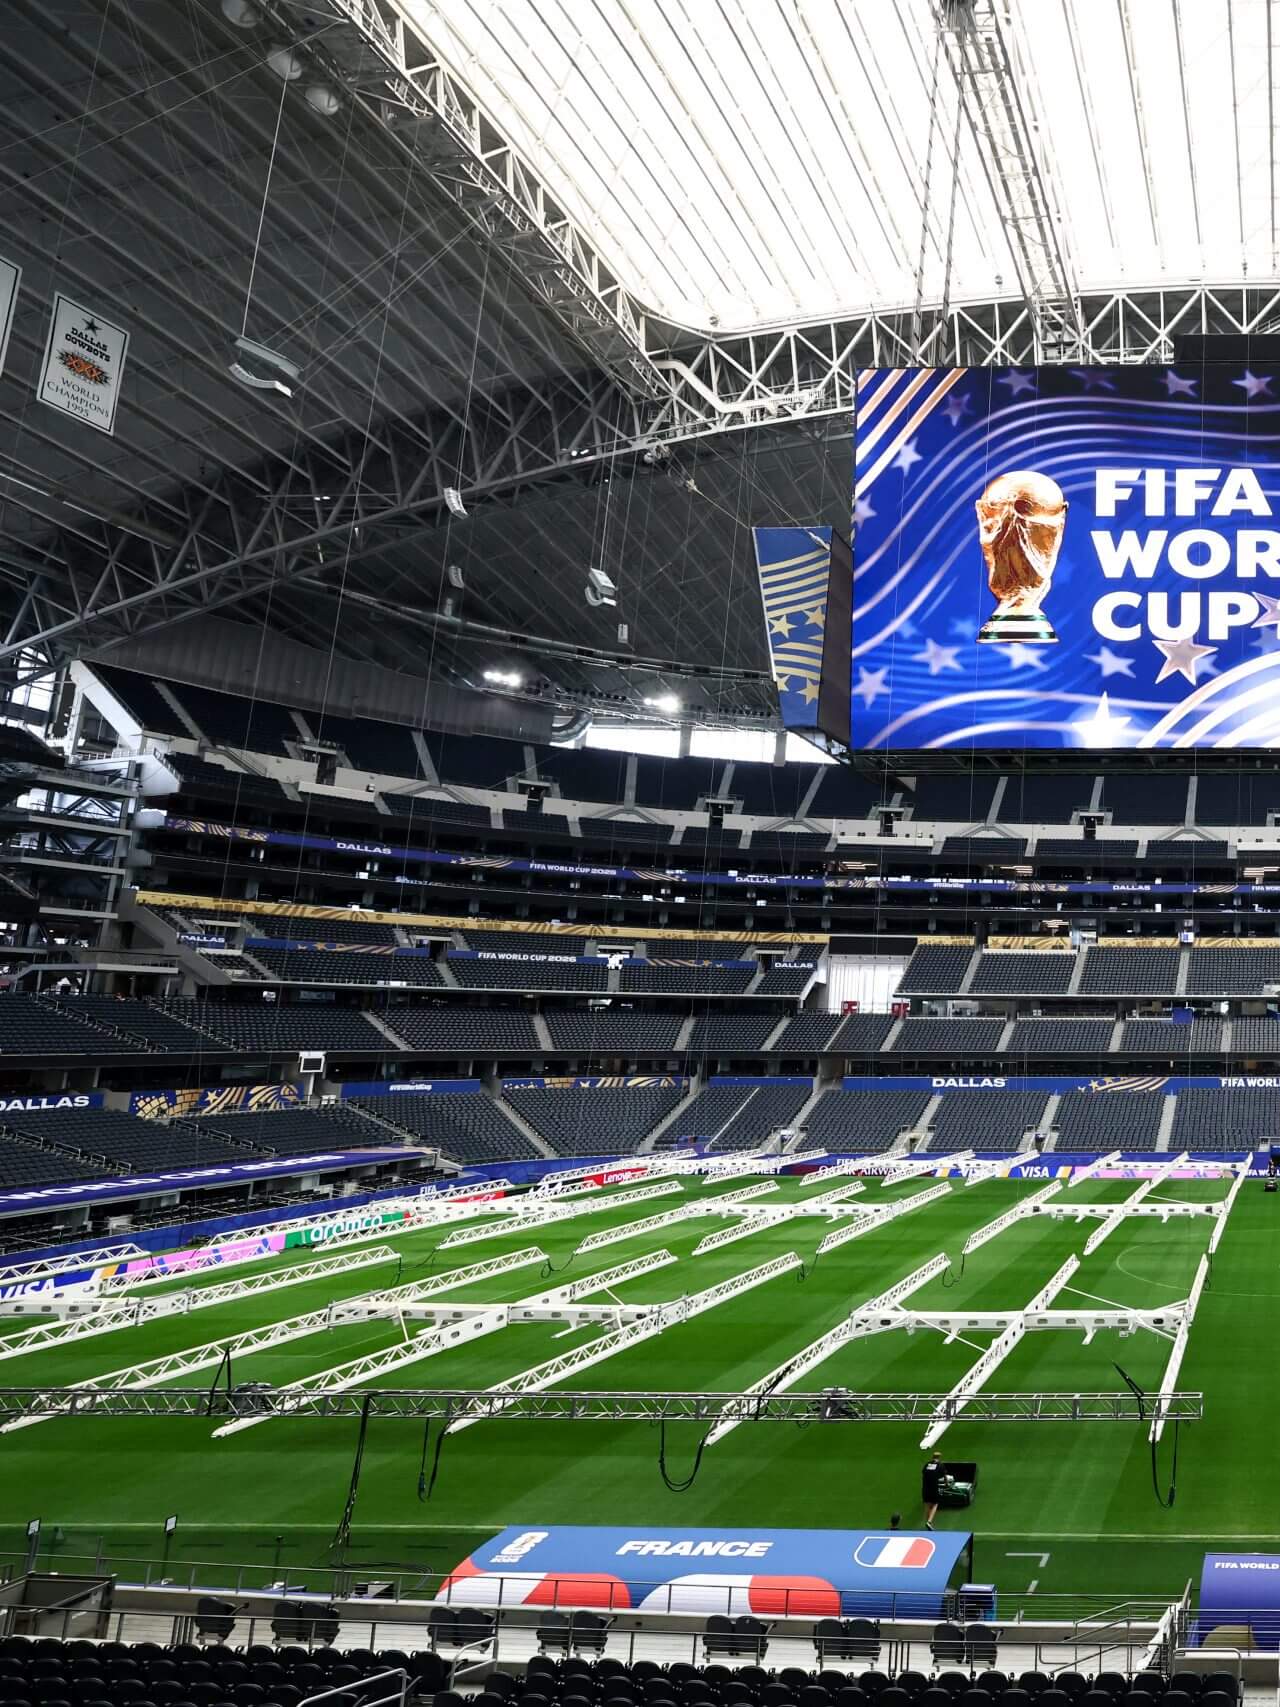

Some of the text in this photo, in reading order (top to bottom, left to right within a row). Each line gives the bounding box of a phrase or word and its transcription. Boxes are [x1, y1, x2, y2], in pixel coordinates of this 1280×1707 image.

[71, 327, 108, 352] DALLAS
[65, 333, 111, 362] COWBOYS
[61, 377, 100, 402] WORLD
[47, 381, 109, 418] CHAMPIONS
[66, 401, 89, 417] 1995
[1094, 468, 1271, 517] FIFA
[1092, 591, 1258, 641] CUP
[336, 841, 392, 855] DALLAS
[529, 863, 546, 871] FIFA
[547, 864, 575, 873] WORLD
[736, 876, 777, 884] DALLAS
[1112, 884, 1151, 892] DALLAS
[478, 952, 497, 960] FIFA
[497, 953, 529, 961] WORLD
[530, 954, 547, 962] CUP
[775, 961, 814, 969] DALLAS
[932, 1077, 1006, 1088] DALLAS
[1221, 1078, 1246, 1088] FIFA
[1020, 1166, 1049, 1178] VISA
[615, 1540, 773, 1558] FRANCE
[1239, 1562, 1280, 1570] WORLD
